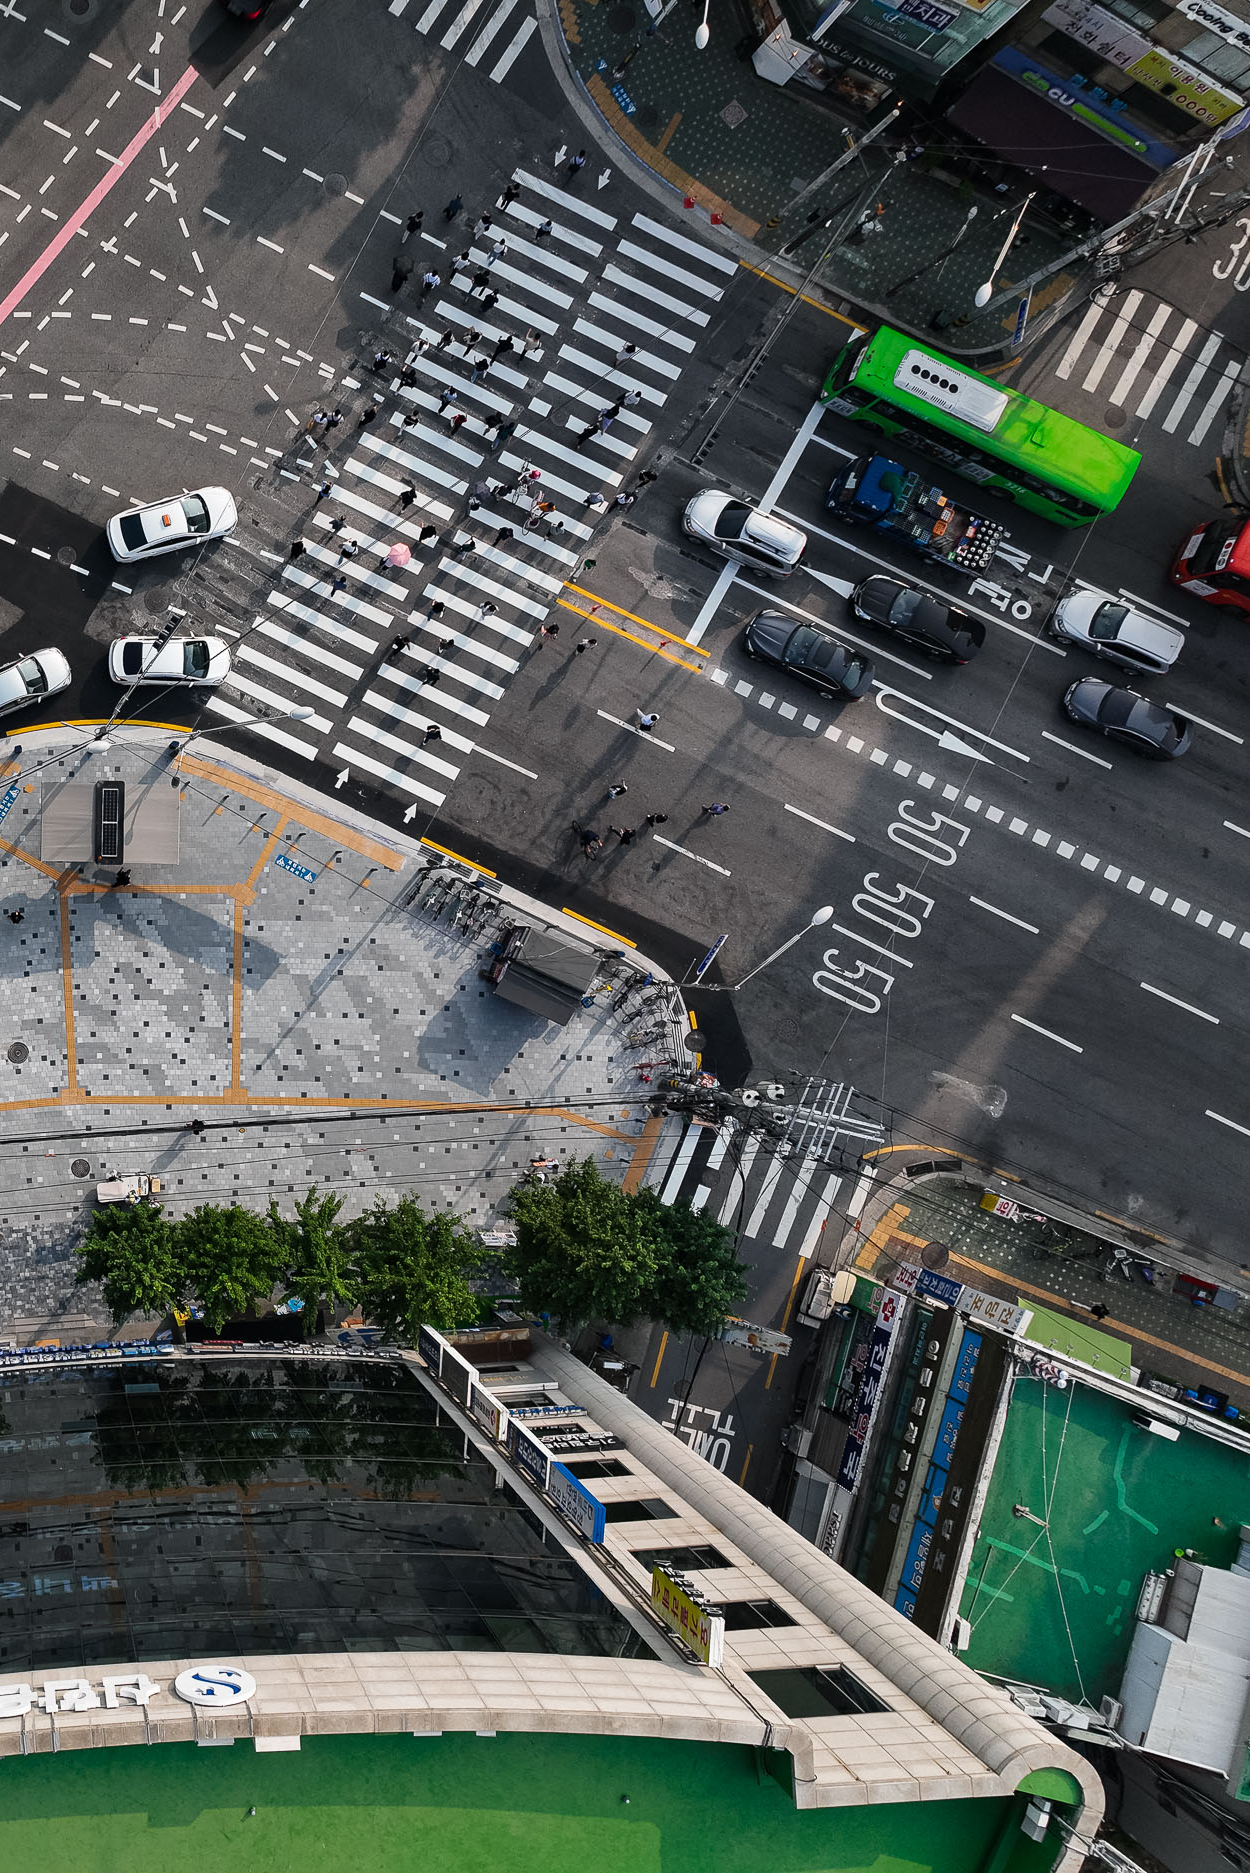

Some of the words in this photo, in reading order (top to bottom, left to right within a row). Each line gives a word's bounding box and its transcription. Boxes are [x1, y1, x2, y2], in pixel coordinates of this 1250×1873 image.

[852, 55, 898, 83] JOURS
[1167, 63, 1210, 96] 이용원
[1046, 86, 1076, 109] CU
[1005, 480, 1027, 496] 3216
[888, 799, 972, 867] 50
[852, 871, 935, 939] 50
[812, 947, 896, 1015] 50
[894, 1265, 918, 1289] 약국
[883, 1302, 895, 1317] 약
[969, 1293, 1015, 1326] 전당포
[840, 1343, 889, 1481] 진주약국
